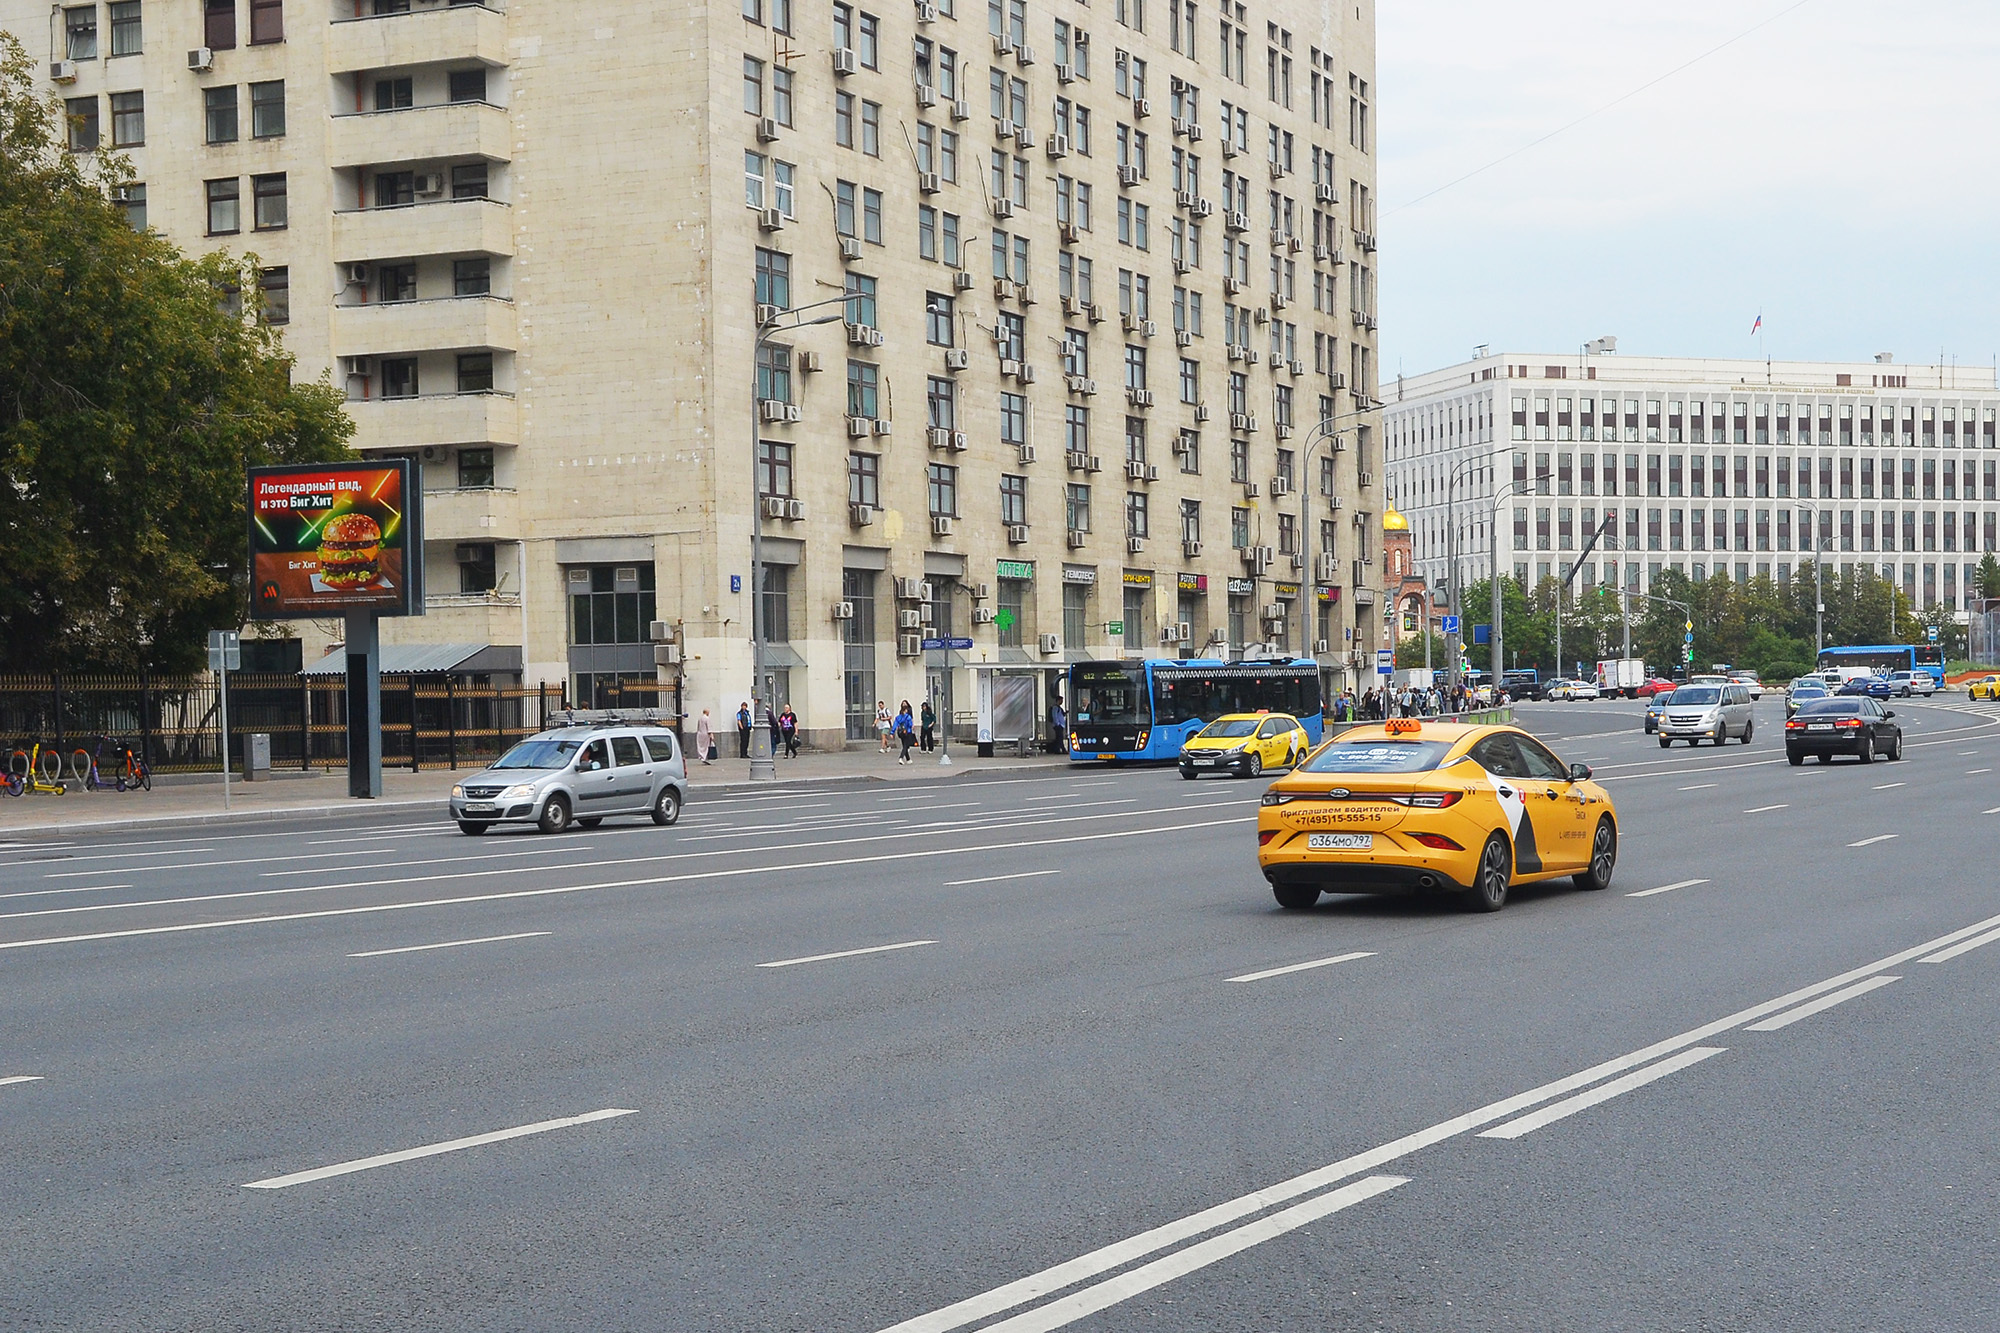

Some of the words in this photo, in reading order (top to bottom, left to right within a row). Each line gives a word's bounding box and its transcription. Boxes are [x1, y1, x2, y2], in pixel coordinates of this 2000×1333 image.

[260, 479, 336, 494] Легендарный
[338, 480, 362, 492] вид,
[260, 500, 268, 509] и
[270, 499, 288, 508] это
[290, 496, 310, 508] Биг
[311, 495, 332, 507] Хит
[288, 561, 301, 569] Биг
[302, 560, 317, 569] Хит
[996, 561, 1032, 578] АПТЕКА
[1065, 570, 1095, 580] ГЕМОТЕСТ
[1280, 807, 1342, 819] Приглашаем
[1344, 805, 1400, 813] водителей
[1295, 813, 1382, 826] +7(495)15-555-15
[1311, 835, 1352, 847] О364МО
[1353, 835, 1370, 844] 797
